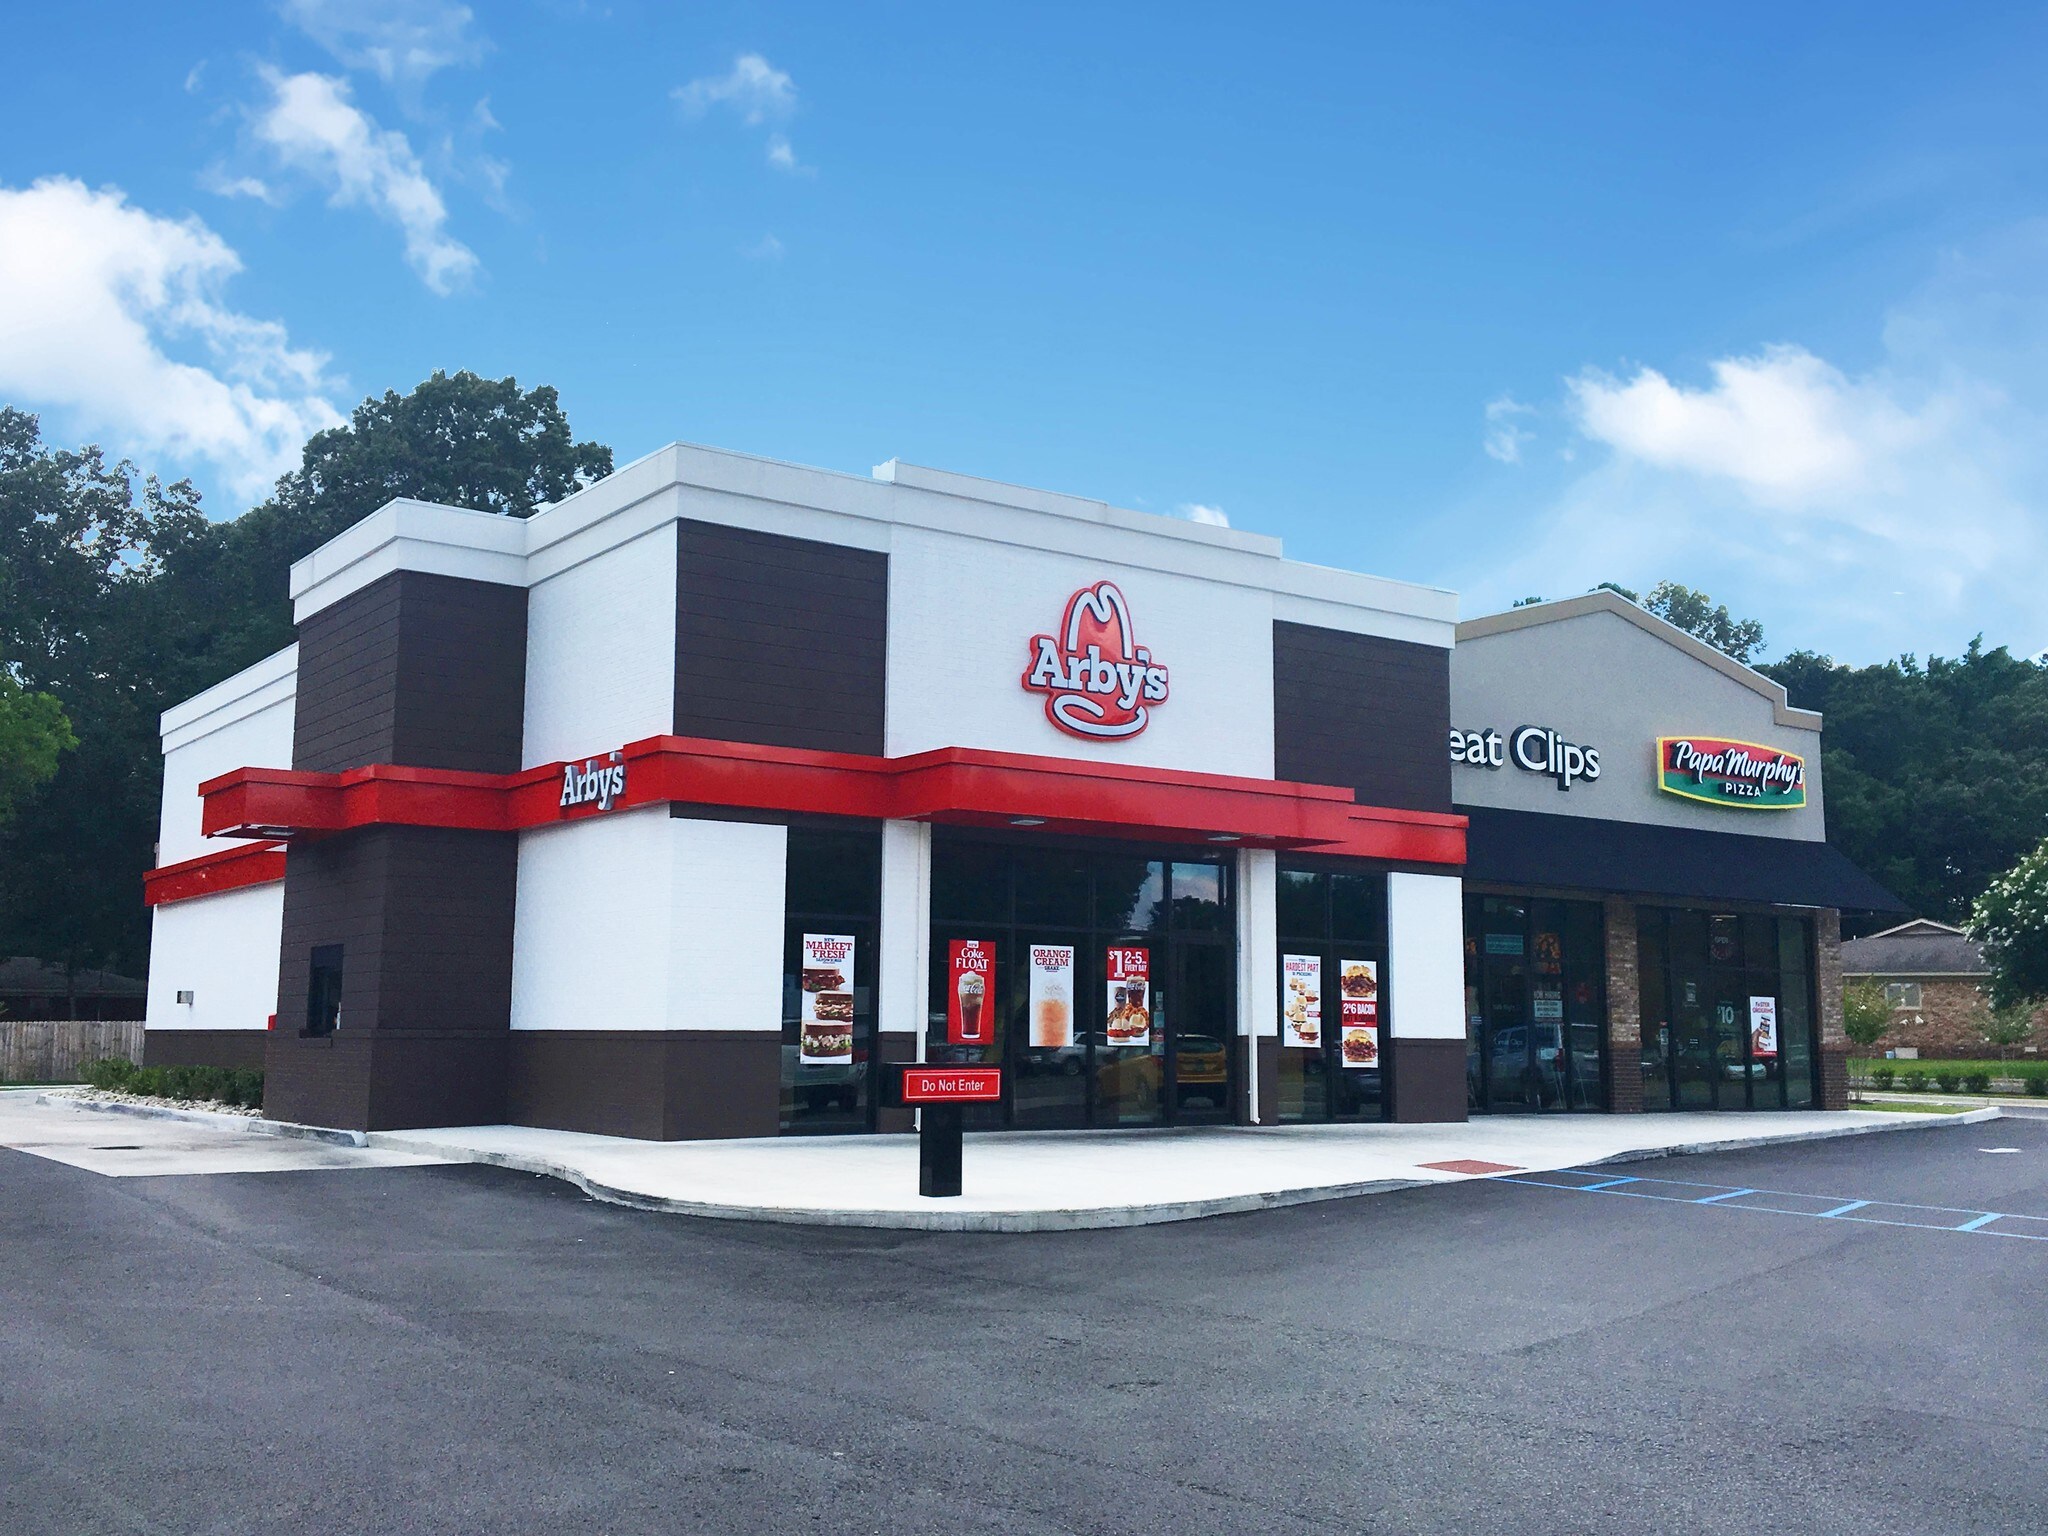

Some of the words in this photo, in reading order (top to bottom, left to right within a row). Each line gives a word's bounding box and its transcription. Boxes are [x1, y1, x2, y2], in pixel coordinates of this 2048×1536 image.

[1029, 637, 1168, 711] Arby's
[1517, 727, 1601, 787] Clips
[1675, 740, 1725, 785] Papa
[1725, 747, 1805, 795] Murphy's
[559, 751, 626, 811] Arby's
[1725, 782, 1762, 798] PIZZA
[806, 941, 853, 951] MARKET
[812, 950, 846, 959] FRESH
[961, 947, 985, 959] Coke
[1033, 949, 1072, 959] ORANGE
[1124, 951, 1143, 964] 2-5
[955, 958, 990, 970] FLOAT
[1035, 957, 1069, 967] CREAM
[1124, 964, 1138, 972] EVERY
[1138, 964, 1147, 972] DAY
[1285, 962, 1306, 972] HARDEST
[1307, 963, 1319, 973] PART
[1357, 1003, 1376, 1015] BACON
[921, 1079, 936, 1092] Do
[938, 1079, 956, 1092] Not
[958, 1078, 985, 1091] Enter
